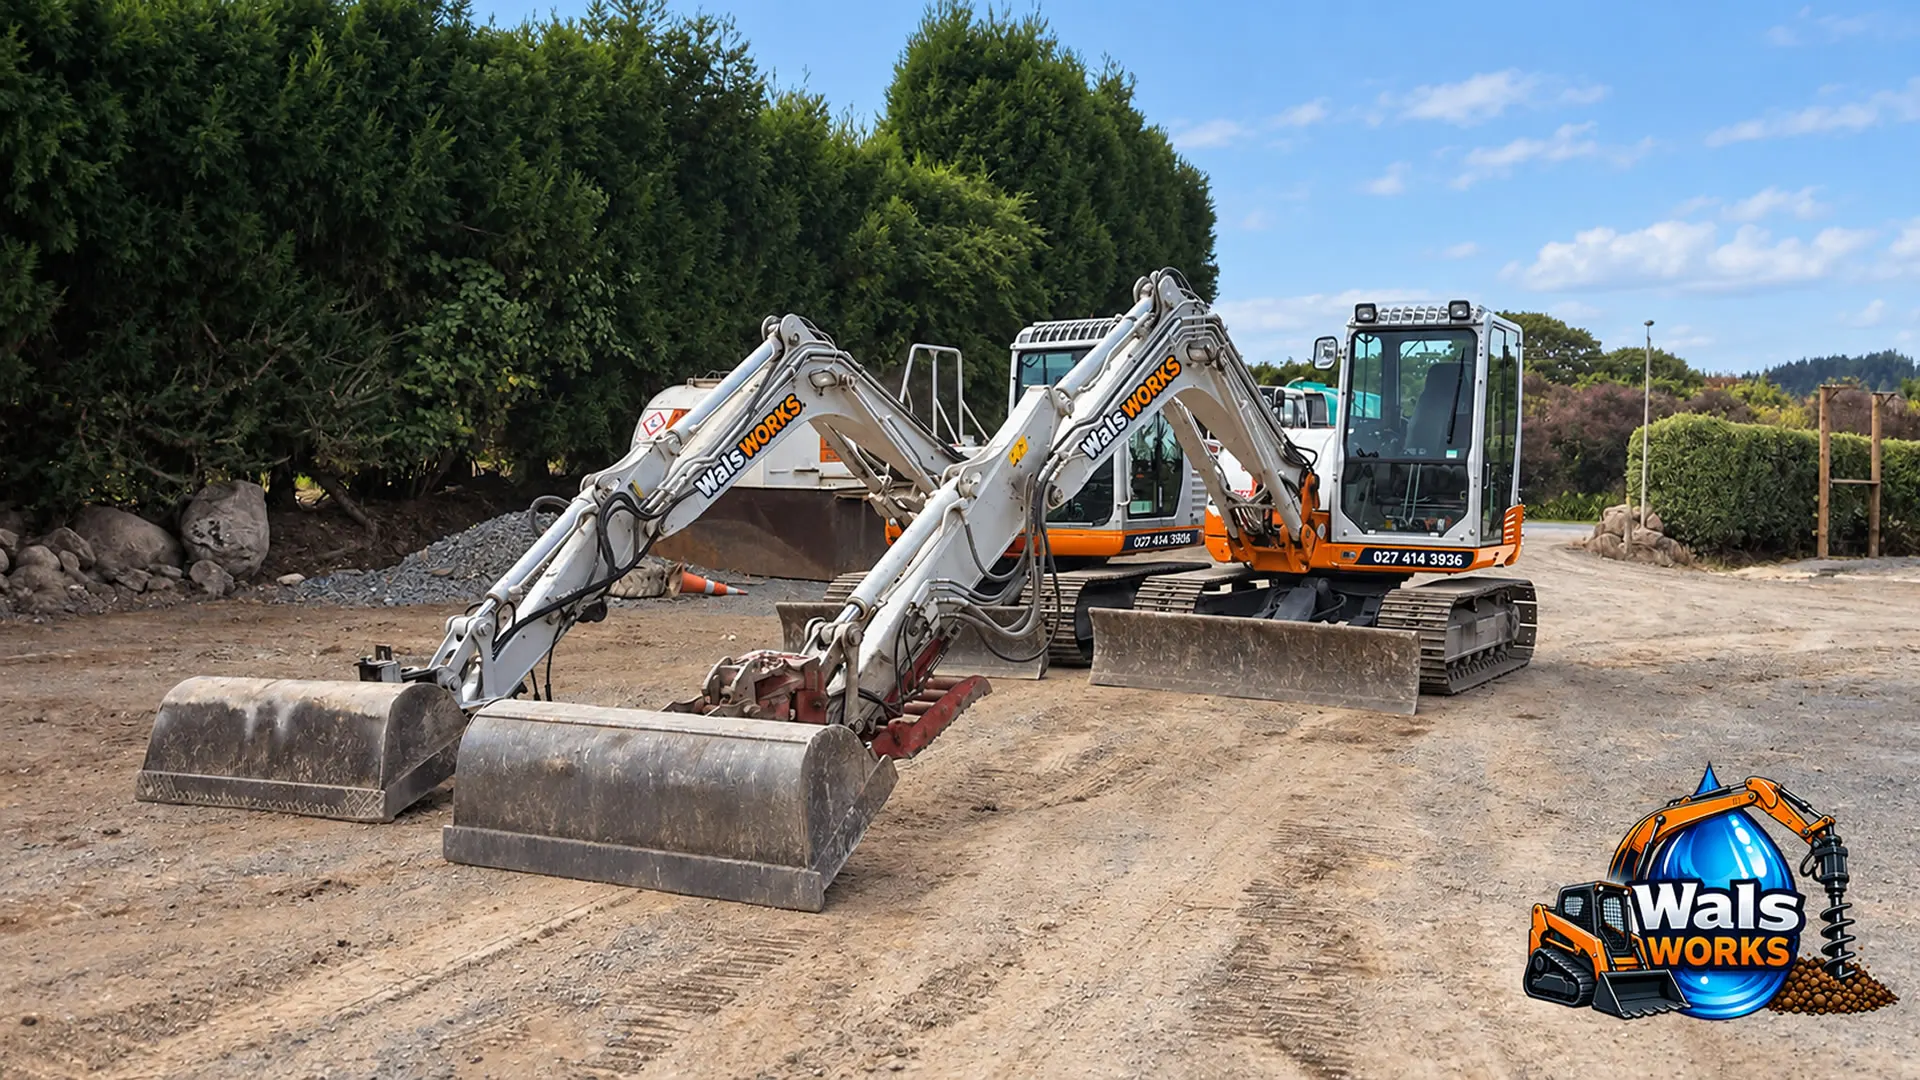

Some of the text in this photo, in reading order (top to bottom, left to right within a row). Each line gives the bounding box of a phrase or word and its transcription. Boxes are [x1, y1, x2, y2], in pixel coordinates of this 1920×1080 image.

[695, 394, 801, 498] Wals WORKS
[1081, 356, 1181, 459] Wals WORKS
[1373, 550, 1463, 566] 027 414 3936
